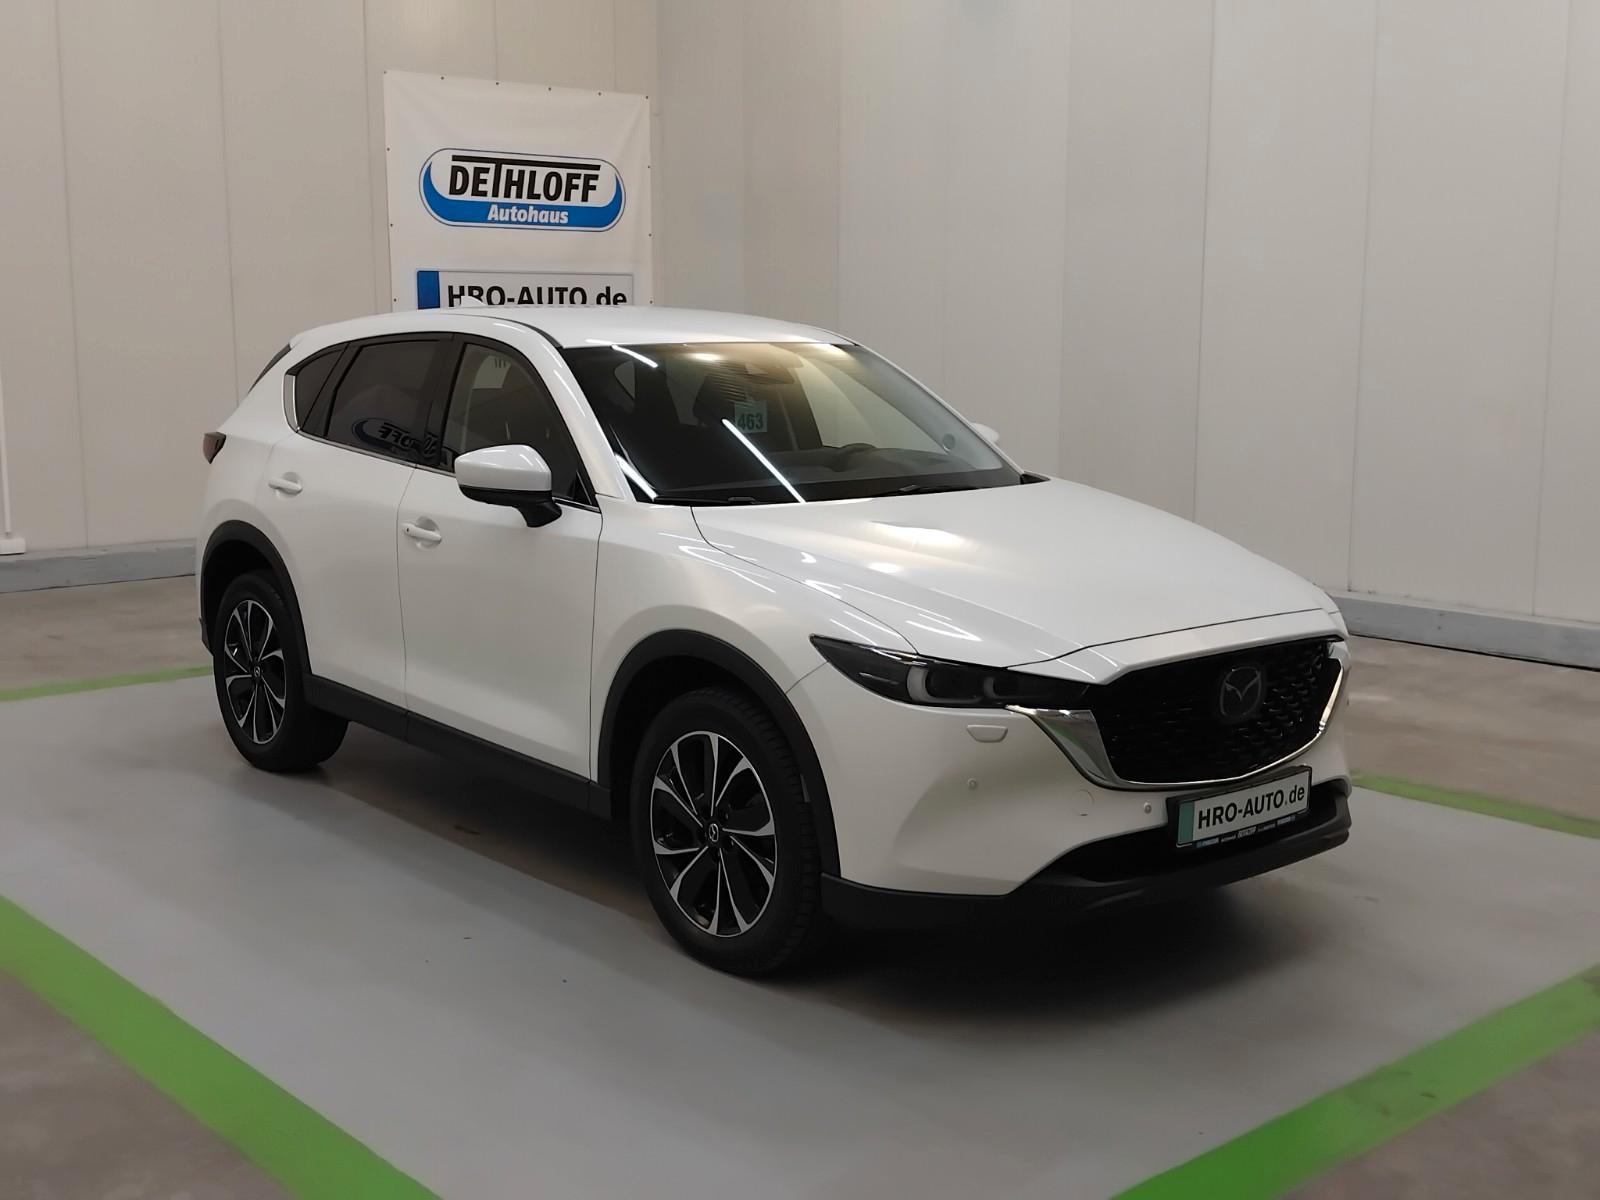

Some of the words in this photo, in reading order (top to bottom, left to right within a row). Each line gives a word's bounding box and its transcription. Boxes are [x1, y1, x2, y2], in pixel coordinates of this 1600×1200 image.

[448, 154, 601, 202] DETHLOFF
[487, 203, 569, 224] Autohaus
[737, 412, 764, 431] 463
[1198, 784, 1305, 829] HRO-AUTO.de
